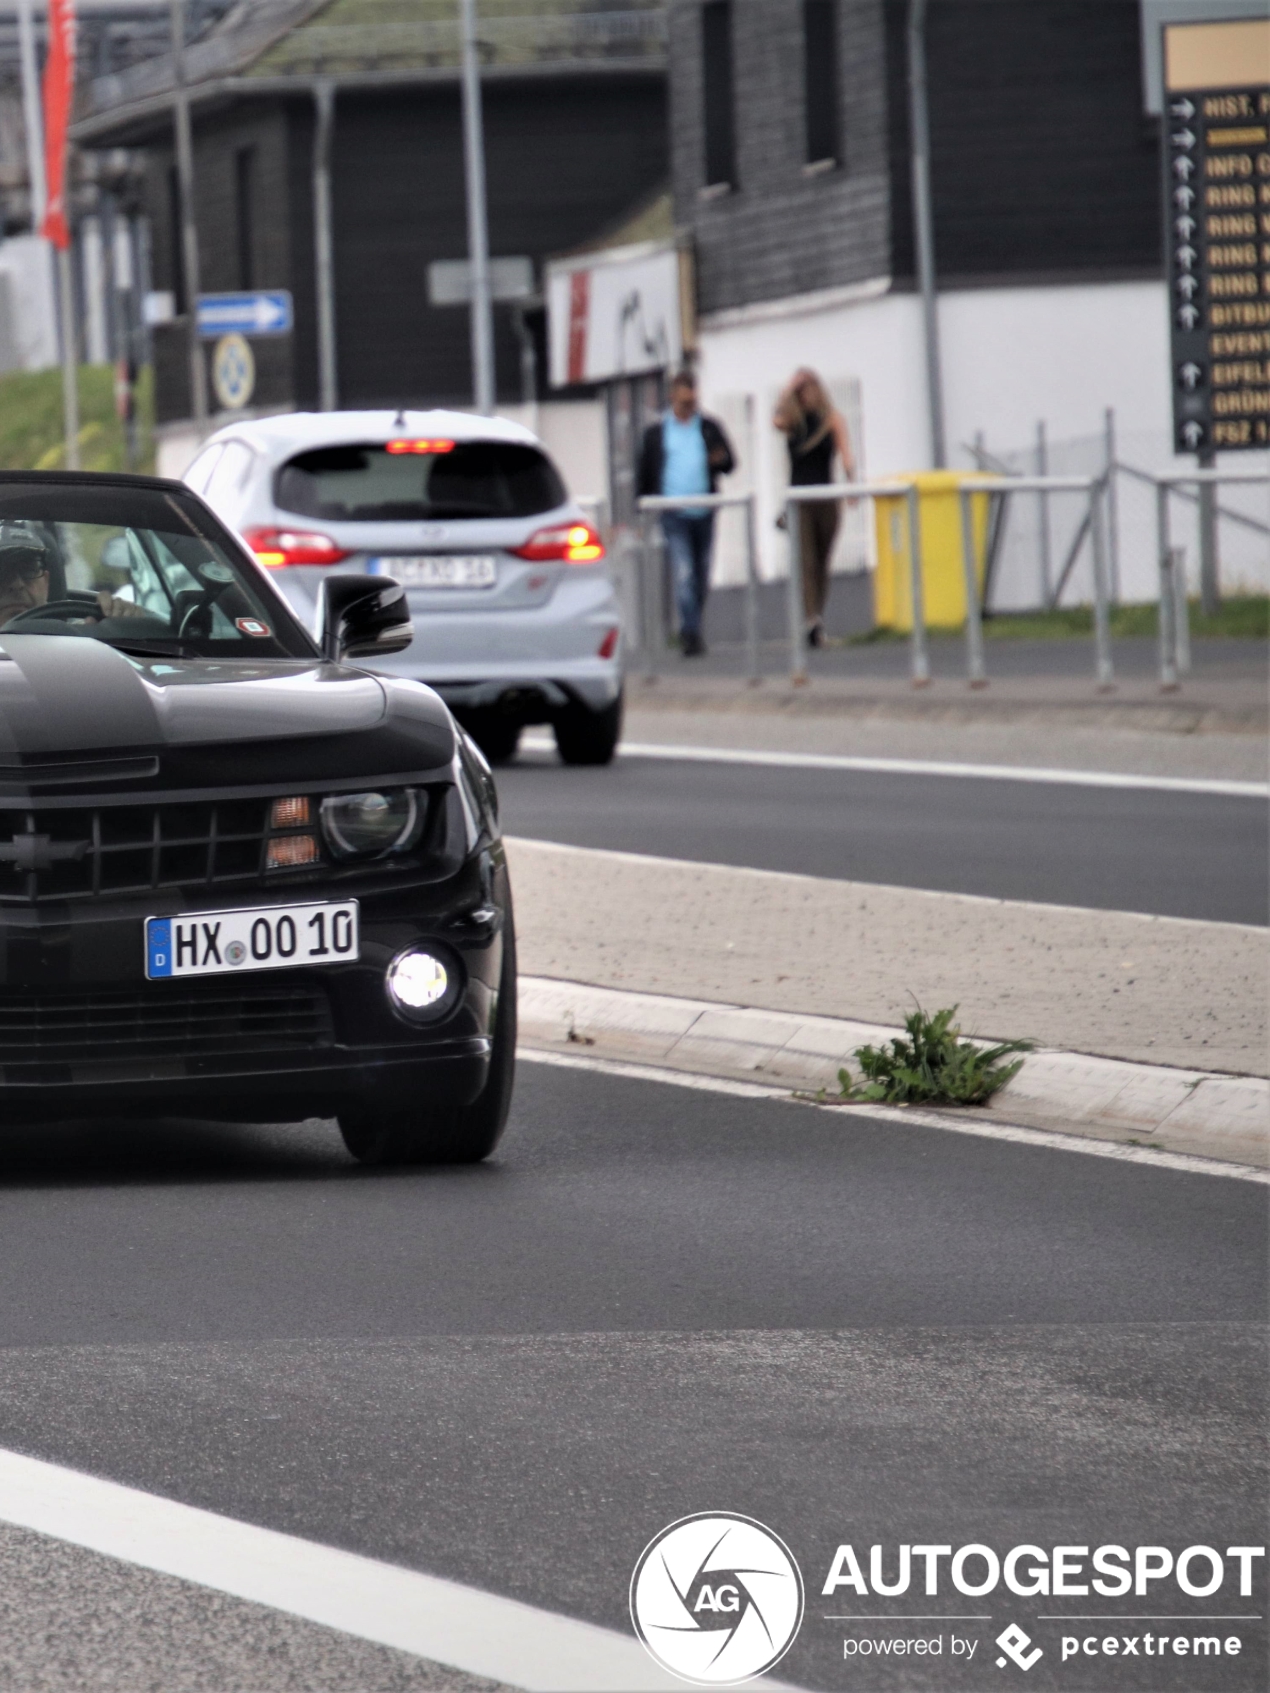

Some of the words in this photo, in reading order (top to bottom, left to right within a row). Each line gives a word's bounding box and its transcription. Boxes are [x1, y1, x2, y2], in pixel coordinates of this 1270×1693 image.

[1204, 94, 1255, 118] HIST.
[1205, 154, 1253, 177] INFO
[1205, 184, 1256, 207] RING
[1207, 213, 1256, 236] RING
[1207, 243, 1258, 267] RING
[1209, 271, 1259, 295] RING
[1213, 361, 1270, 386] EIFEL
[1214, 388, 1270, 415] GRÜN
[155, 953, 166, 967] D
[176, 921, 222, 967] HX
[309, 909, 353, 956] 10
